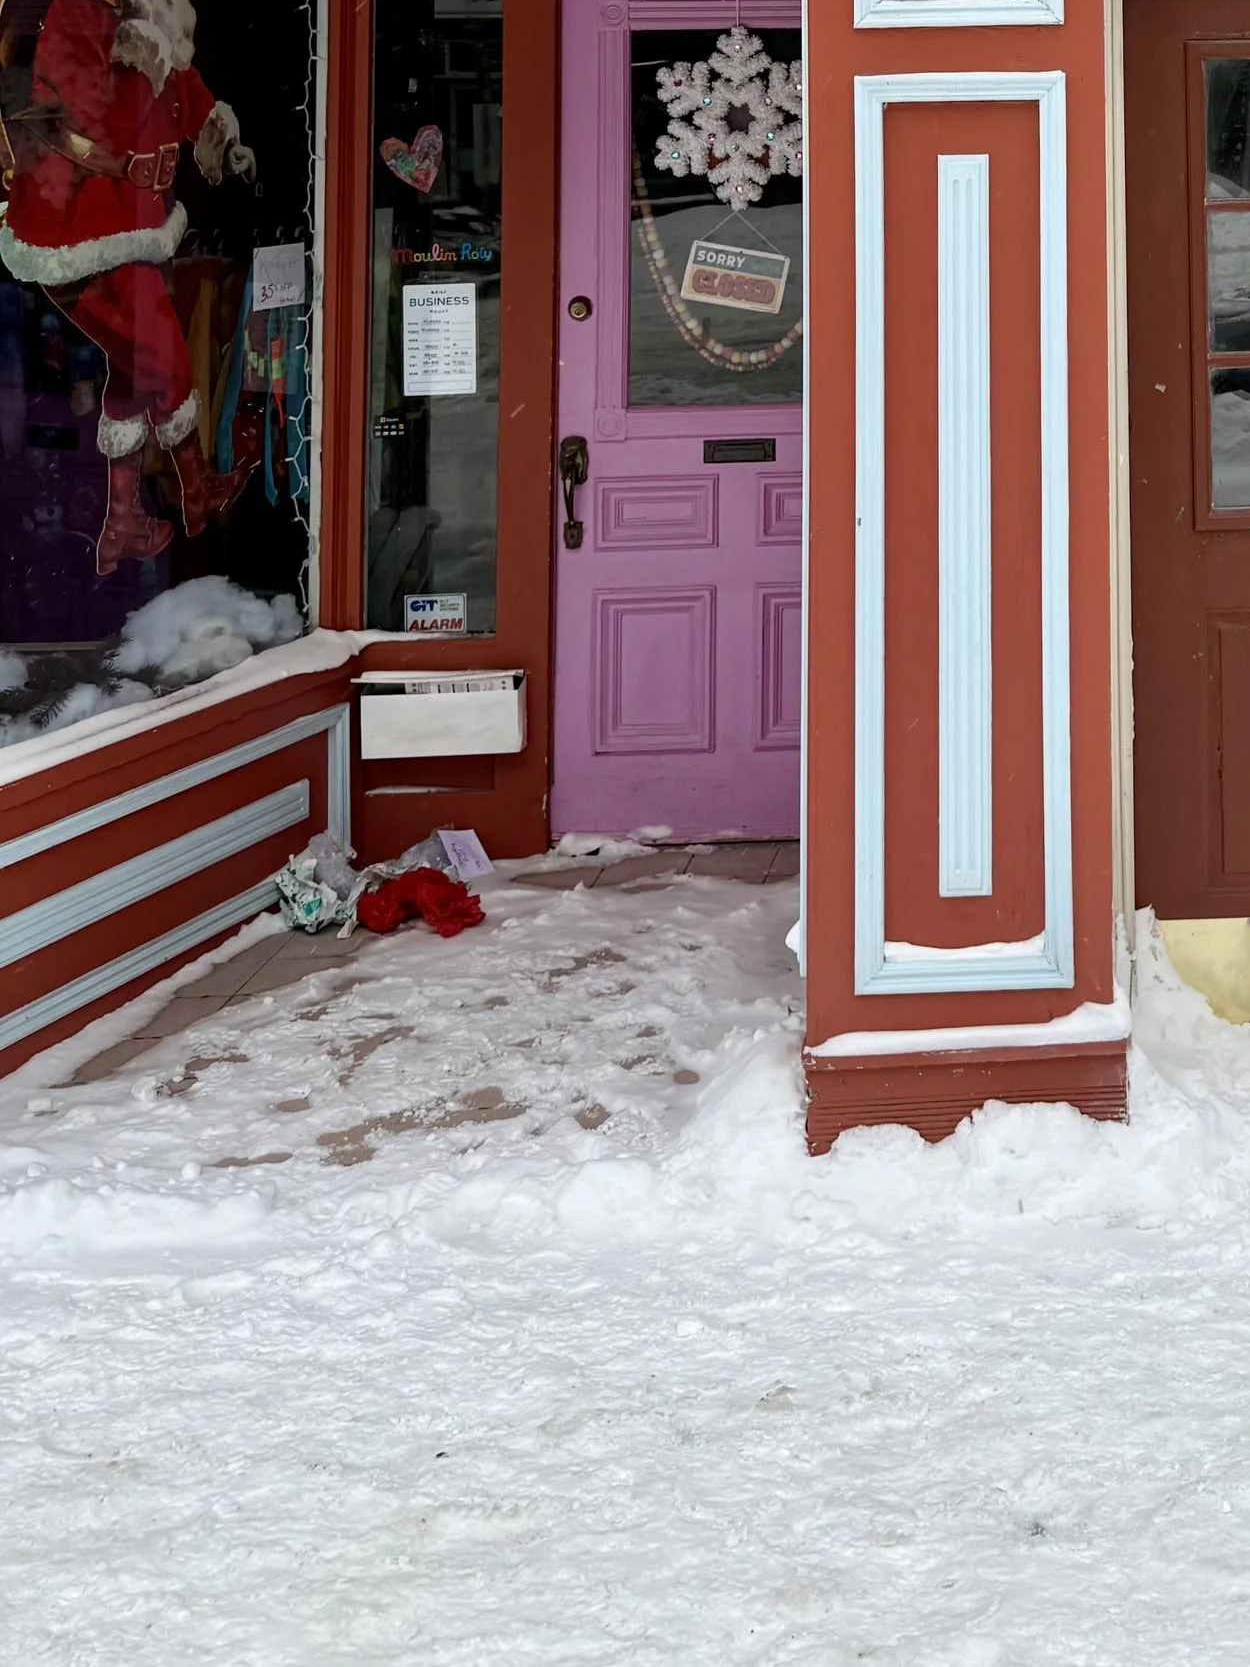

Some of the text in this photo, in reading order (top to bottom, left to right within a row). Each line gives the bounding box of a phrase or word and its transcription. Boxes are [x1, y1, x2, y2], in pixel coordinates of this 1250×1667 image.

[391, 241, 493, 265] Moulin Roty
[696, 250, 746, 268] SORRY
[691, 269, 776, 304] CLOSED
[409, 296, 470, 307] BUSINESS
[409, 618, 463, 631] ALARM
